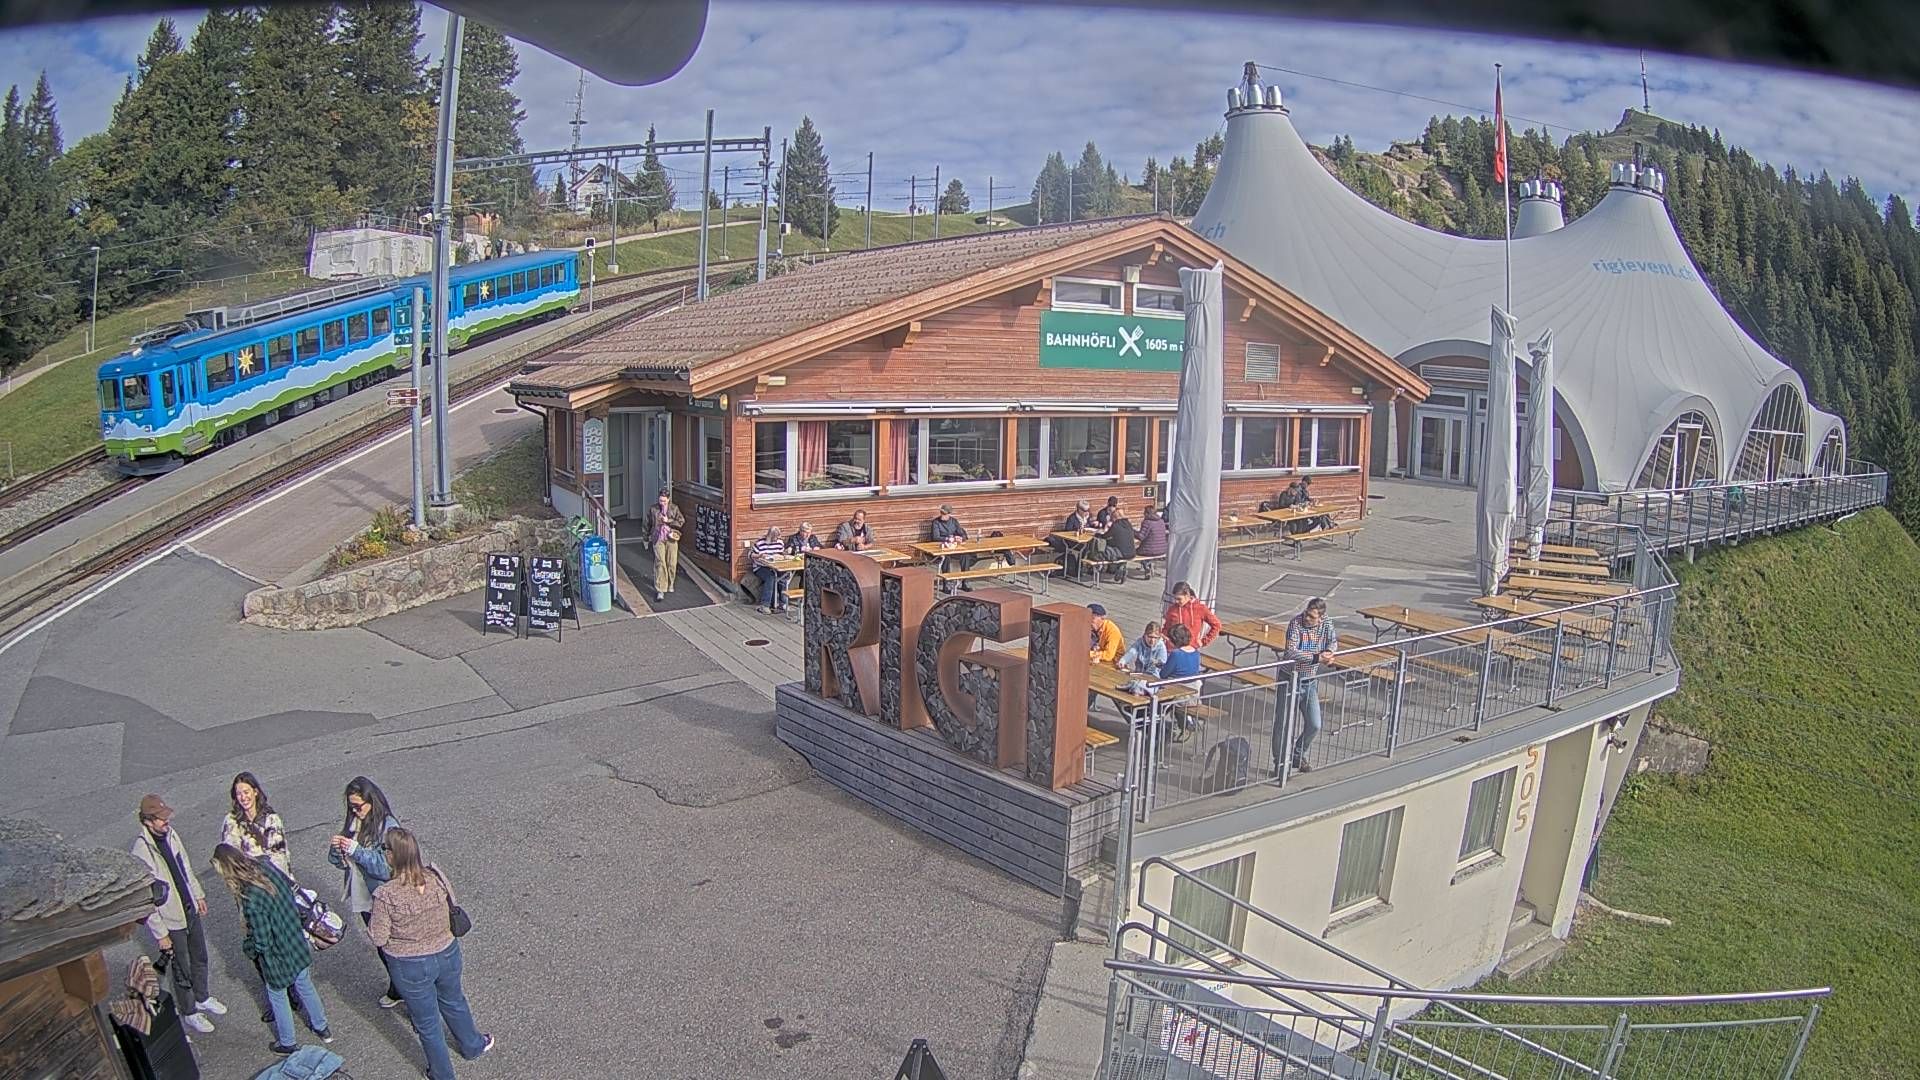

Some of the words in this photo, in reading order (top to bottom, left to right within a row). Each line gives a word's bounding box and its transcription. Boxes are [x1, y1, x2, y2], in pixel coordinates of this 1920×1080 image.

[1046, 331, 1116, 349] BAHNHÖFLI
[1145, 337, 1168, 352] 1605
[804, 549, 1090, 791] RIGI
